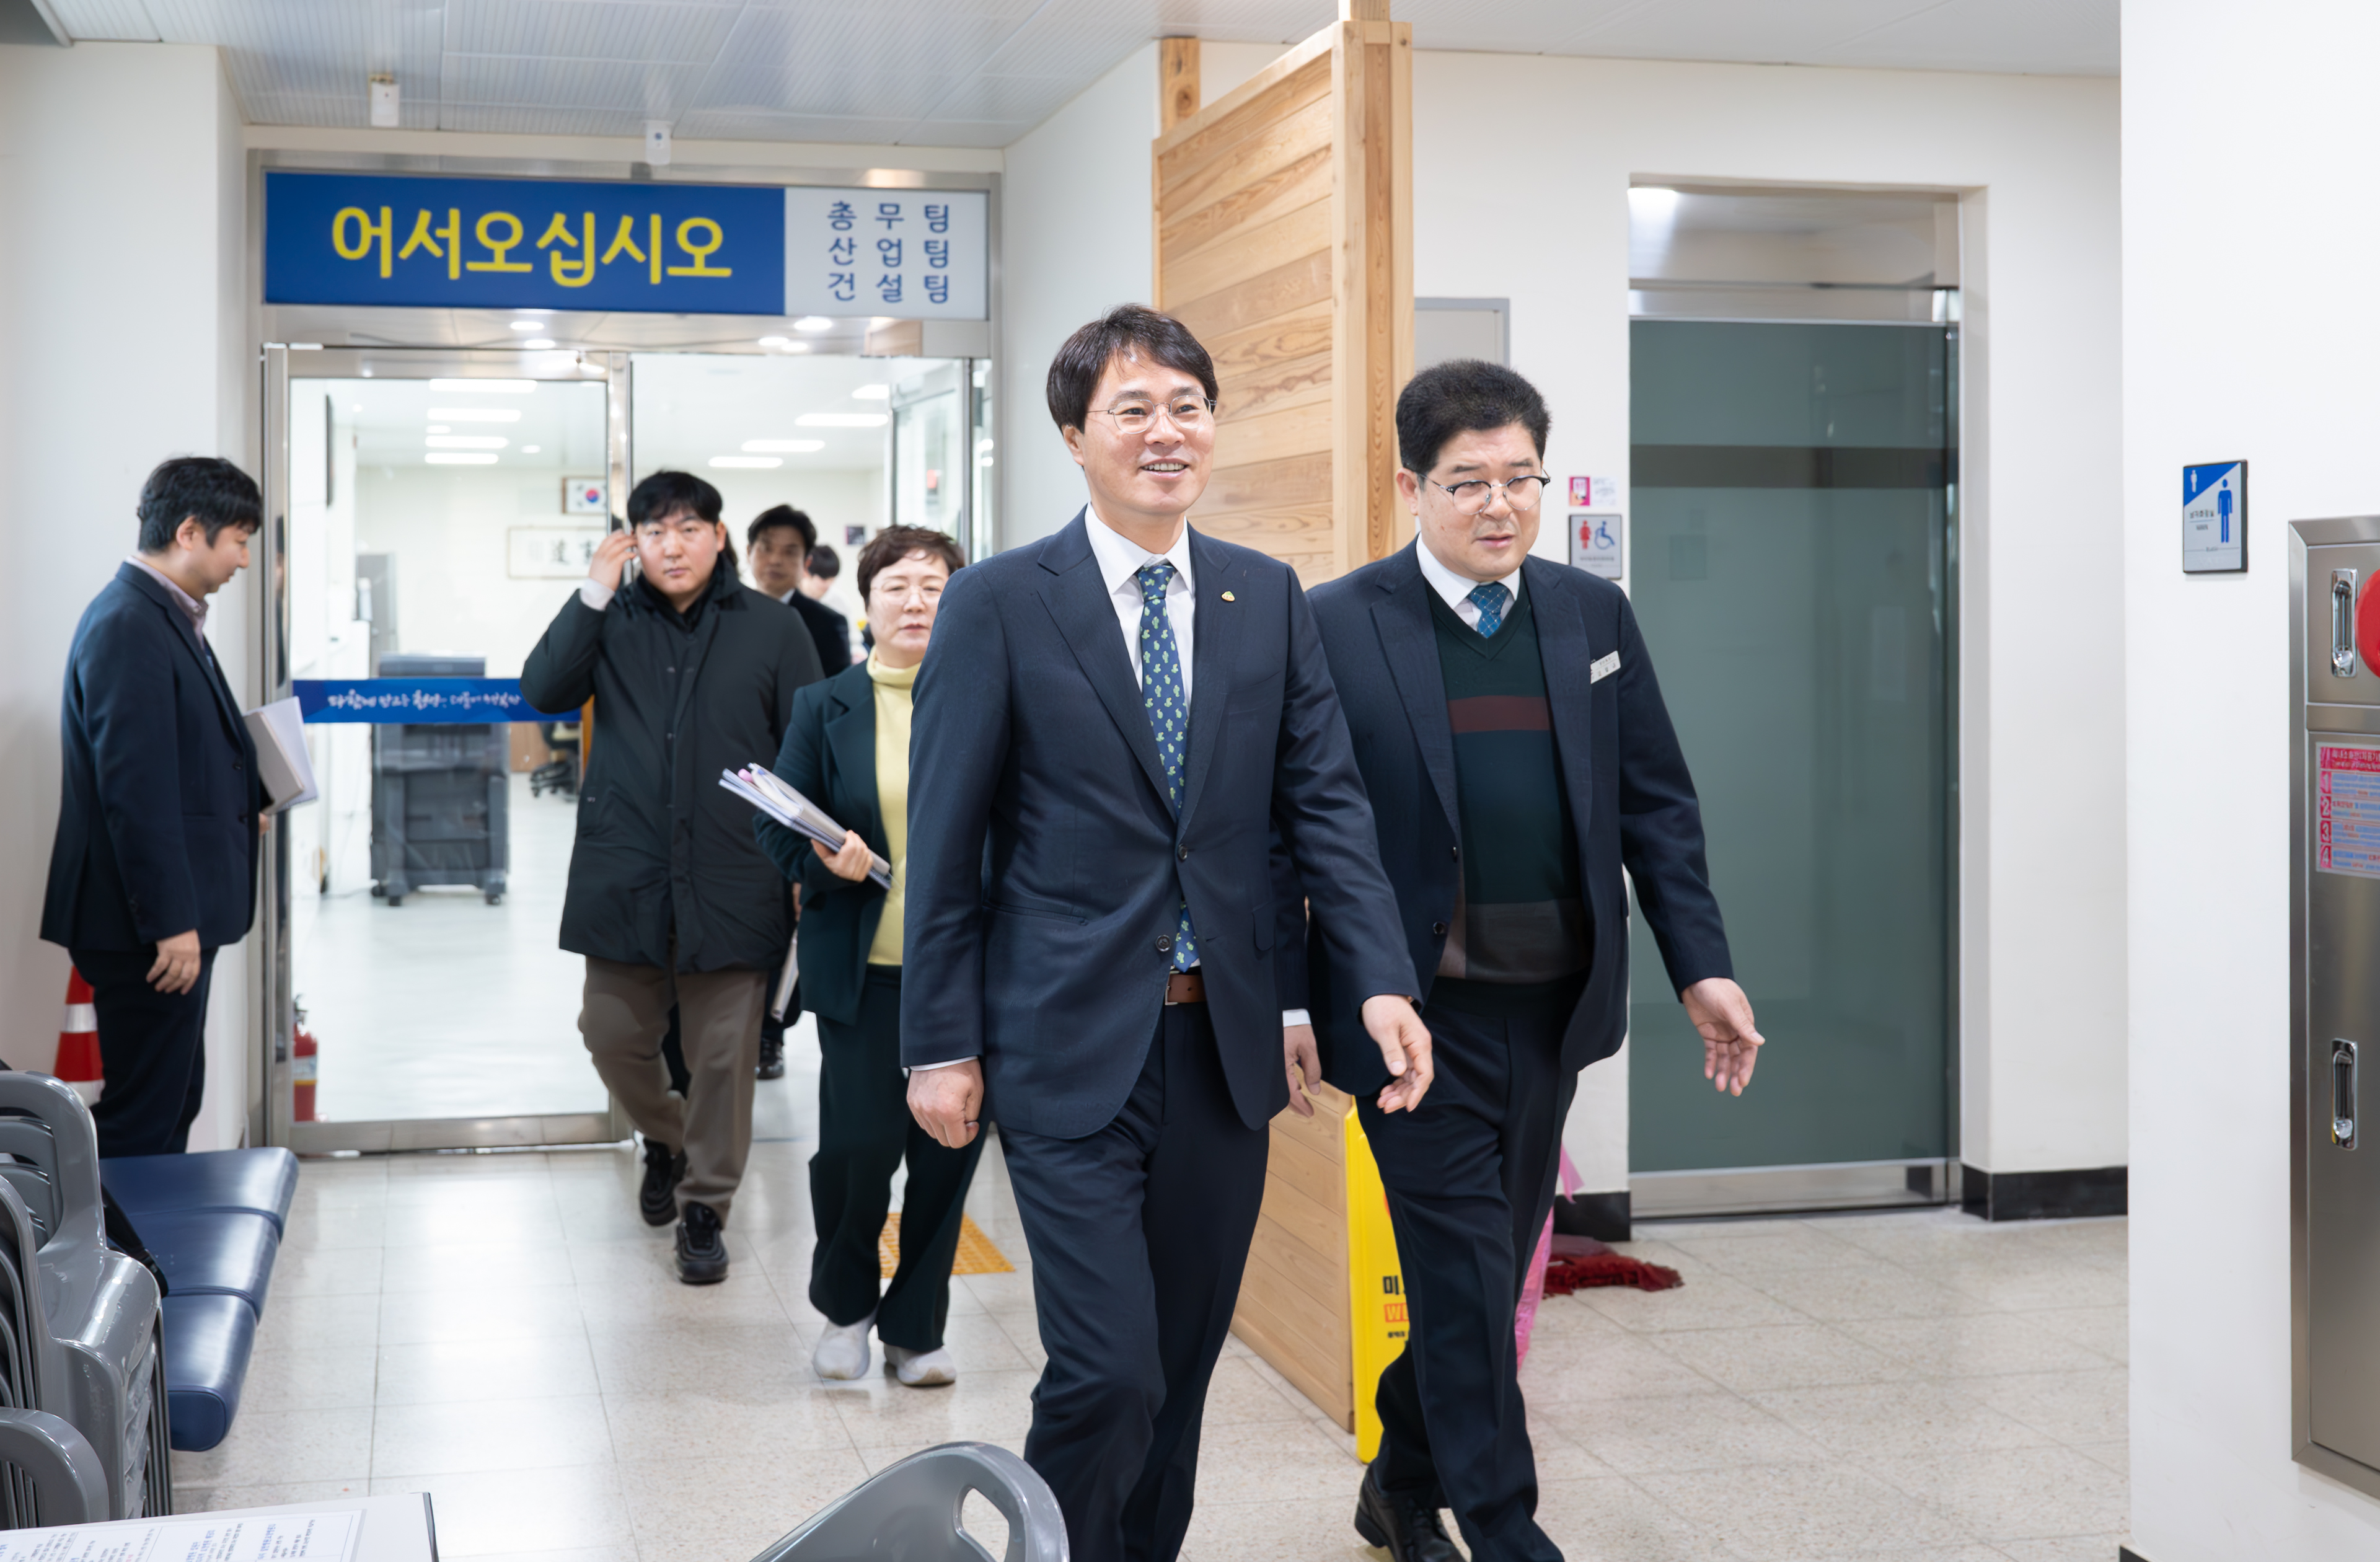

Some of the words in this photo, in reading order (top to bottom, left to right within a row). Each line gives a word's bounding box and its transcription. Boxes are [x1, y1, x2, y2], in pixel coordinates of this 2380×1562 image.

[332, 205, 733, 288] 어서오십시오
[2322, 798, 2329, 816] 2
[2322, 823, 2329, 842] 3
[2322, 847, 2329, 865] 4
